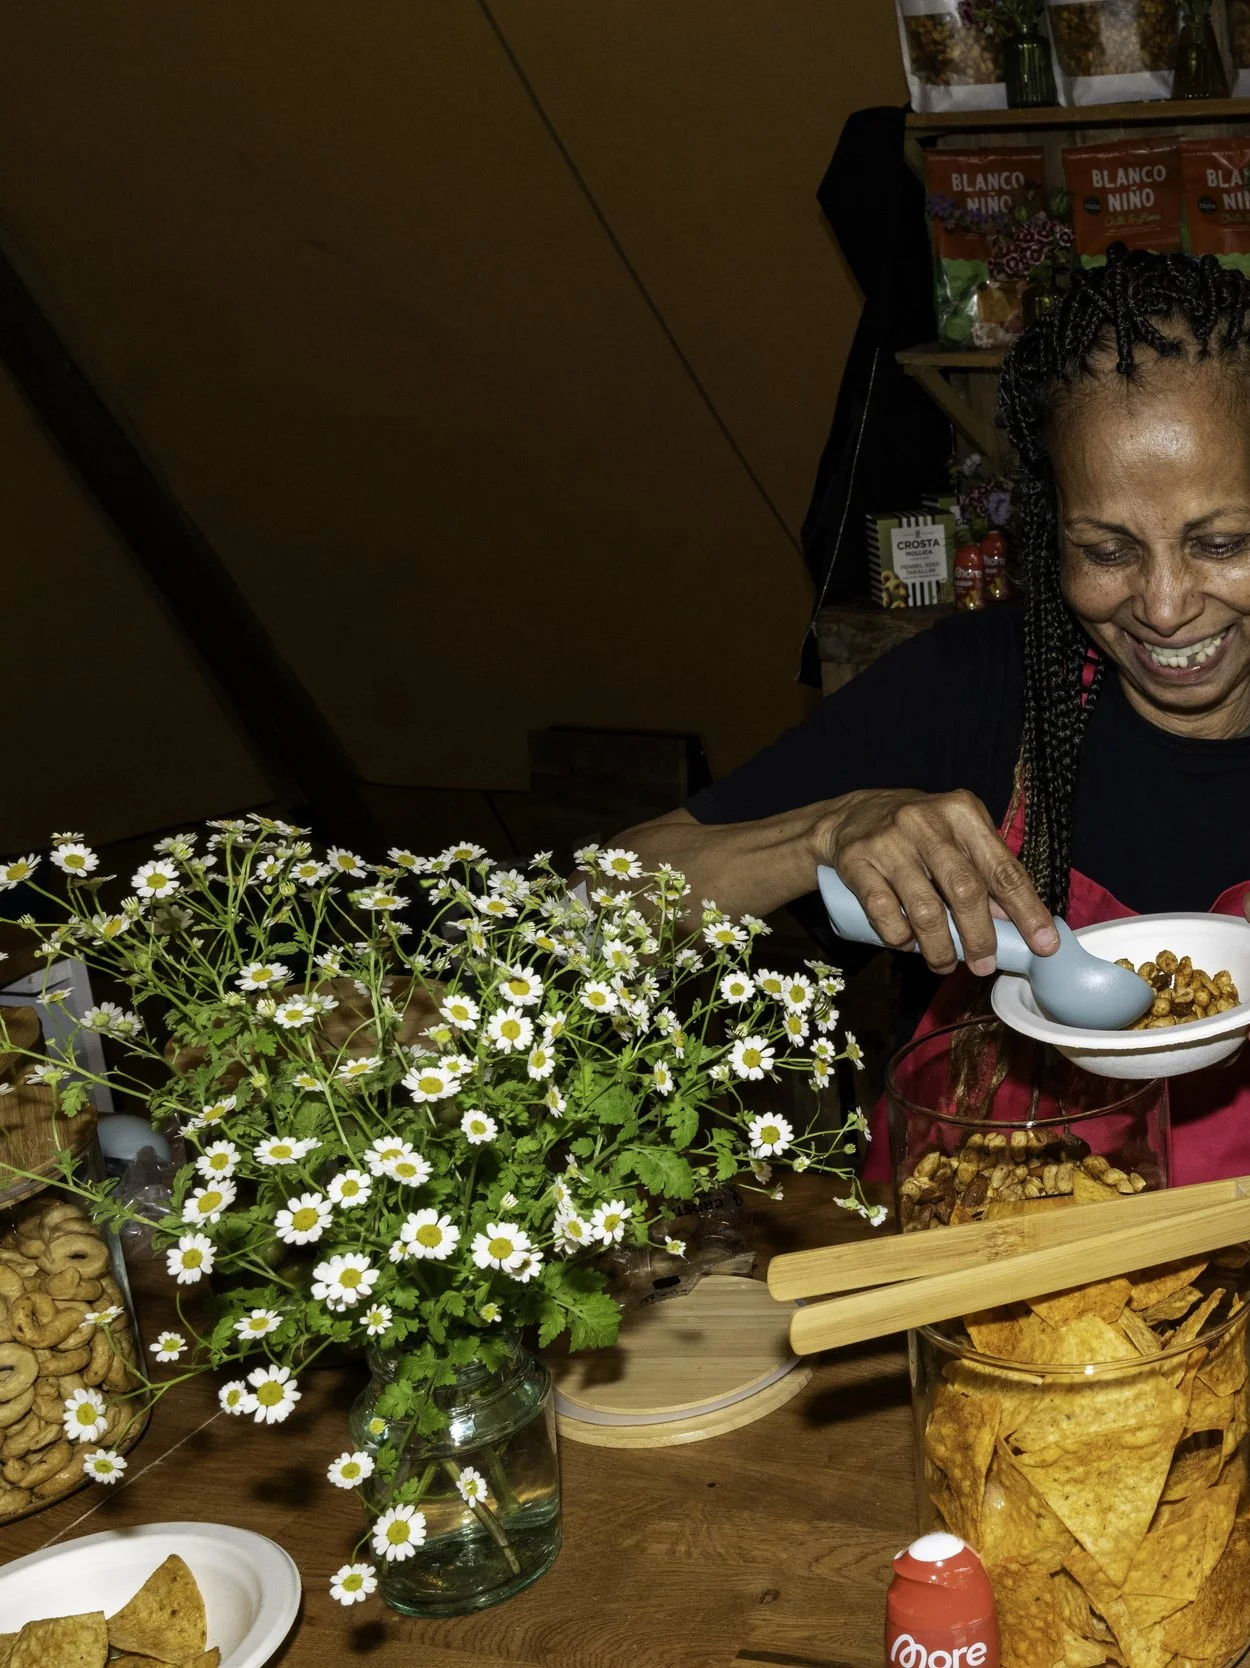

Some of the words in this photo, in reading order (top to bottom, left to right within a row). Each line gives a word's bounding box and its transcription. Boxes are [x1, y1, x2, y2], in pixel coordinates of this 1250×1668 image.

[951, 171, 1025, 192] BLANCO
[1091, 164, 1167, 189] BLANCO
[1107, 185, 1155, 212] NIÑO
[896, 539, 940, 551] CROSTA
[905, 549, 933, 558] MOLLICA
[890, 1633, 988, 1668] More
